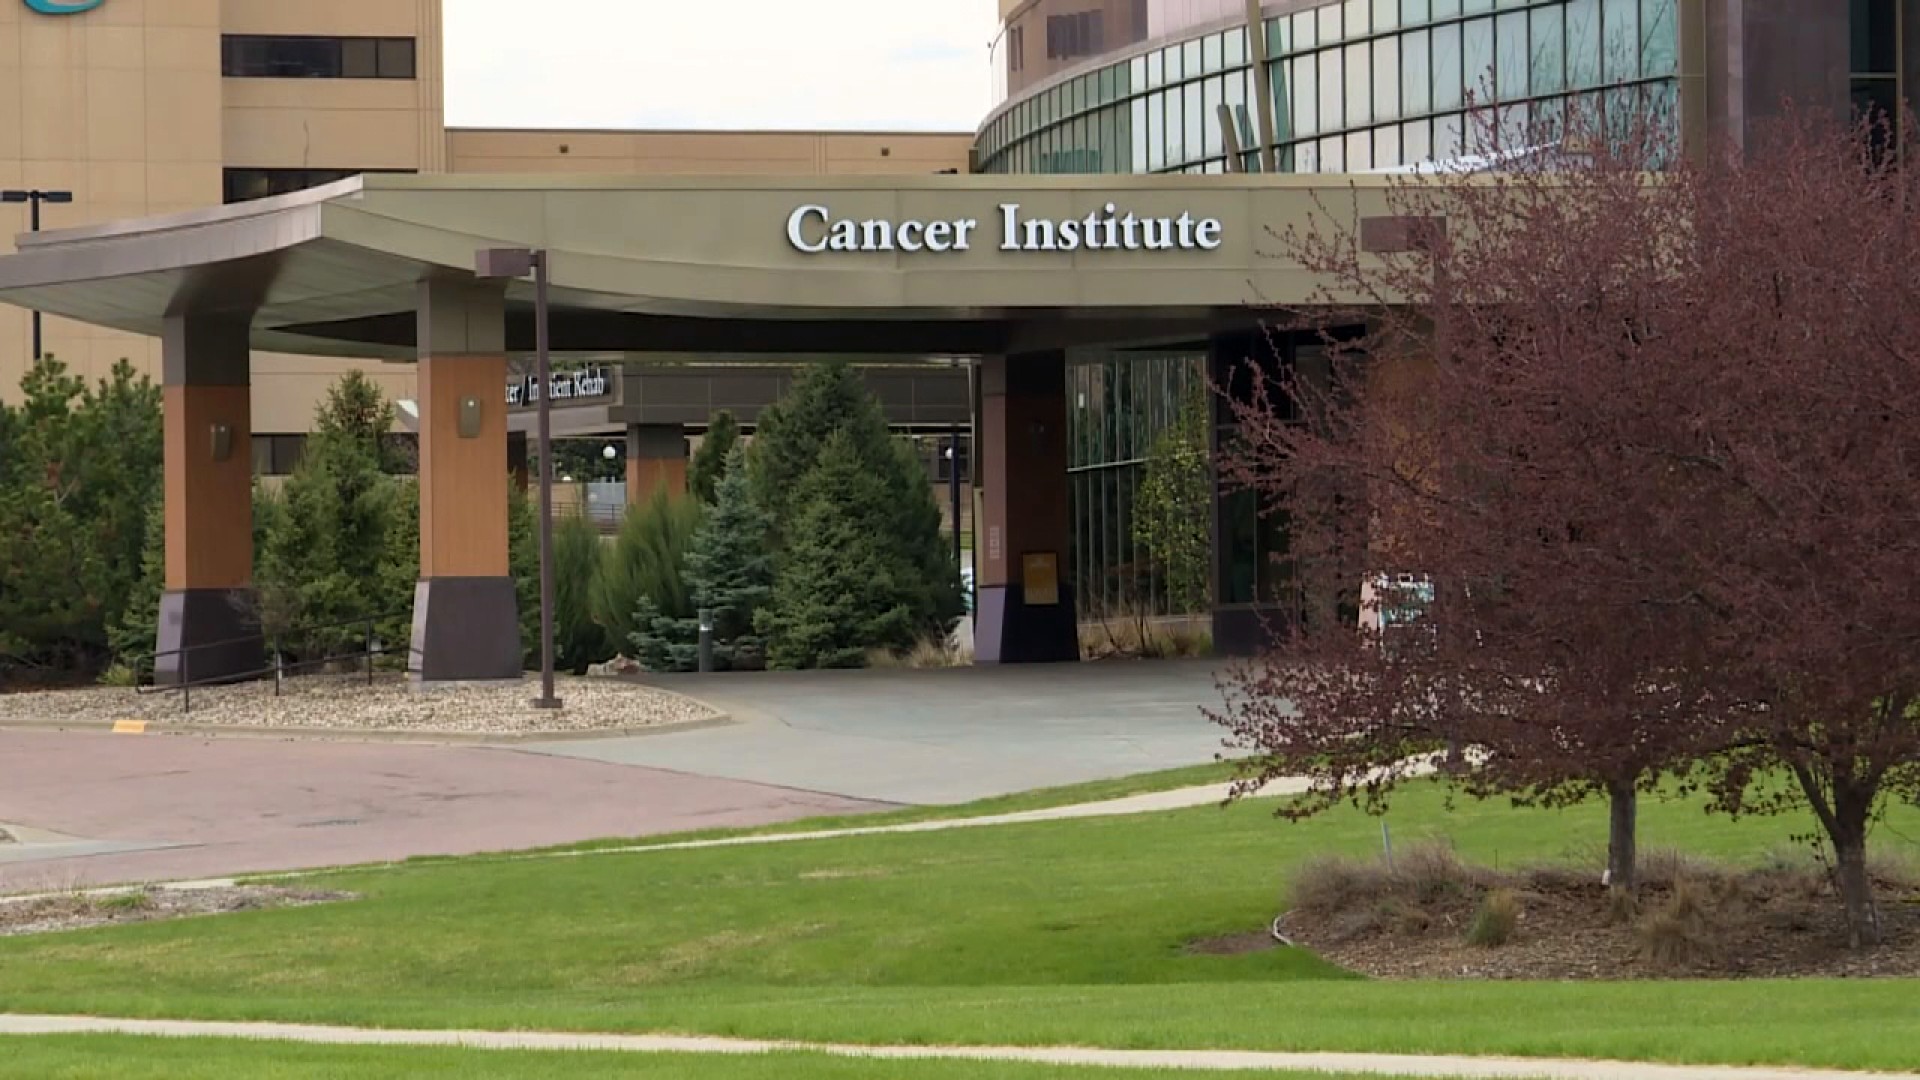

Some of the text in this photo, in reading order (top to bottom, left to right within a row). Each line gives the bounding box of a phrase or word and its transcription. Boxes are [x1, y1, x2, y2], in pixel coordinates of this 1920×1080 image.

[786, 202, 1222, 253] Cancer Institute
[528, 372, 571, 401] Intient
[573, 368, 604, 397] Rehab
